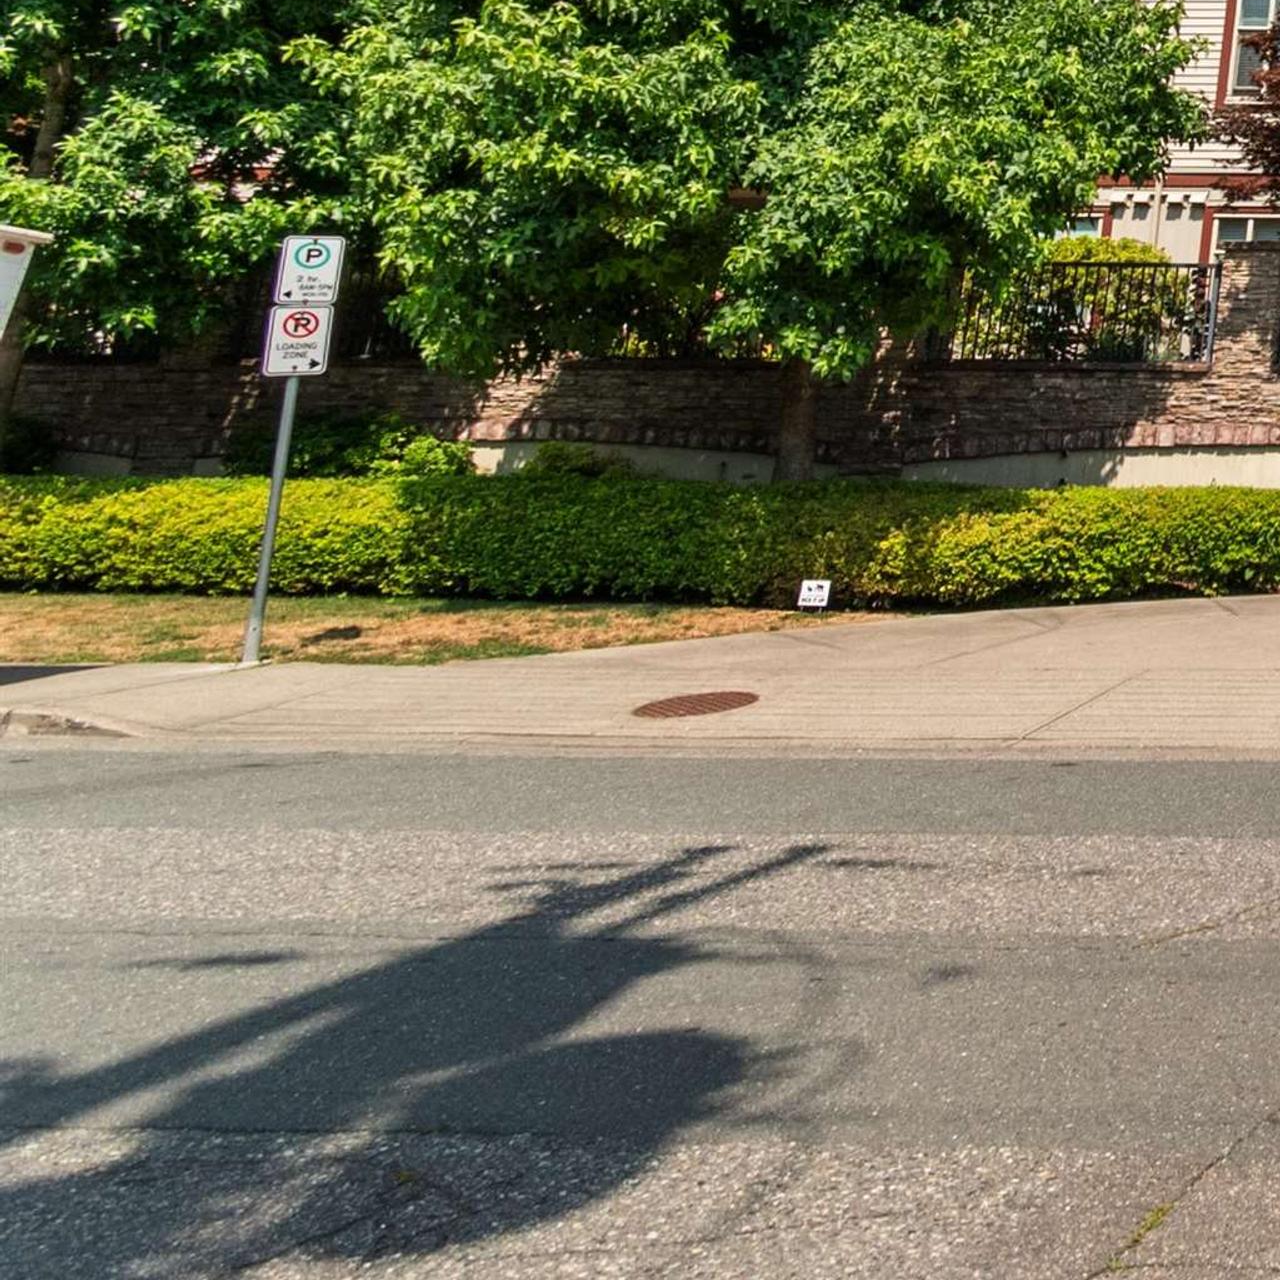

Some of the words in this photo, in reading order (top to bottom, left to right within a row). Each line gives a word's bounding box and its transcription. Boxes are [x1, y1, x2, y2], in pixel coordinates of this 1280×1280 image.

[306, 248, 323, 263] P
[276, 341, 318, 351] LOADING
[282, 351, 309, 359] ZONE
